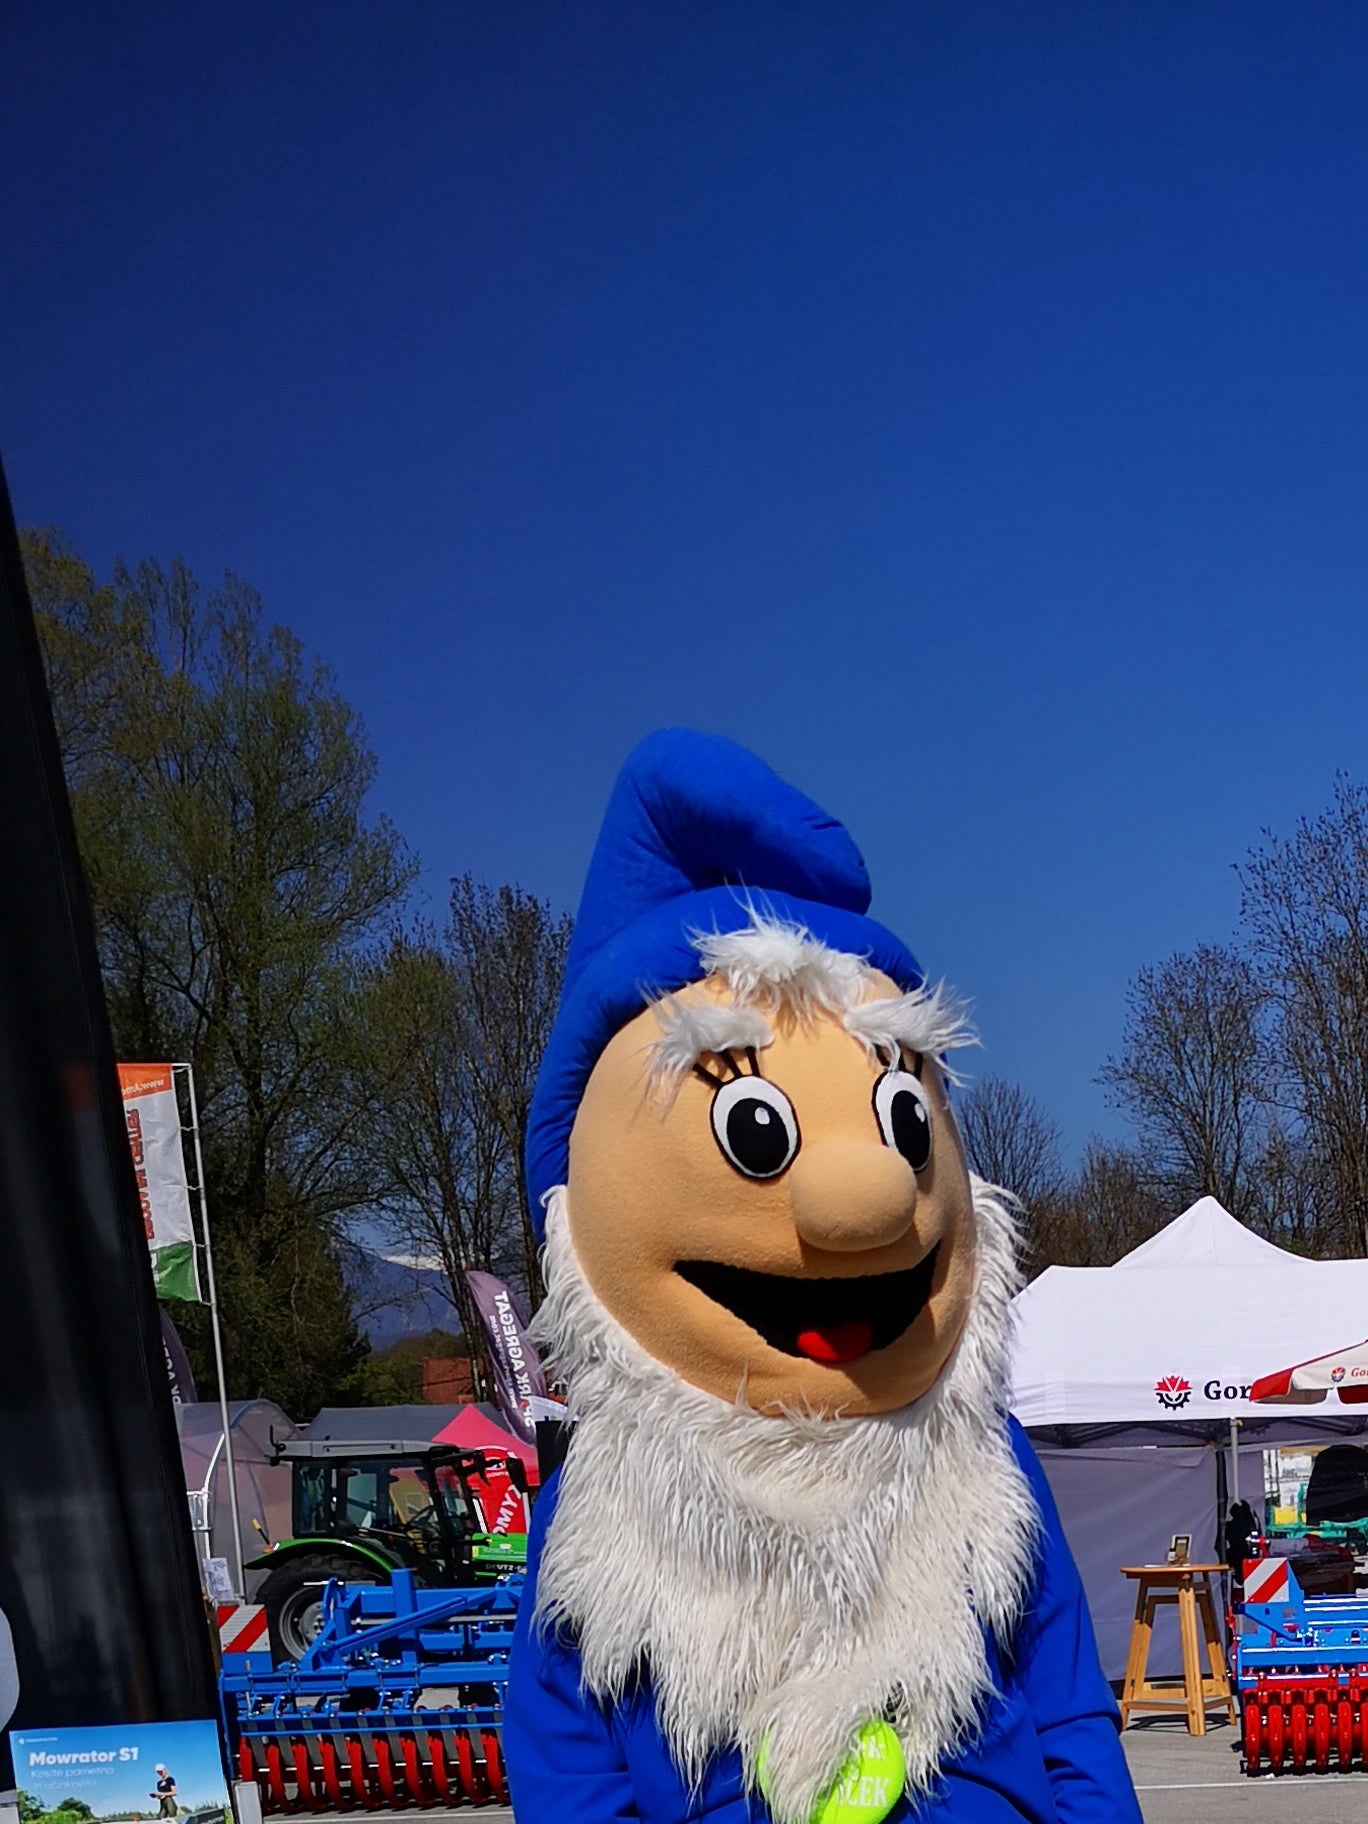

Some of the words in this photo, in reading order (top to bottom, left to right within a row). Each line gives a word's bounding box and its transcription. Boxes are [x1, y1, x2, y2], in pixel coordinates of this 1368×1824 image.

[1204, 1380, 1250, 1400] Gor
[29, 1751, 116, 1767] Mowrator
[119, 1747, 139, 1762] S1
[31, 1768, 65, 1779] Kosite
[65, 1766, 115, 1779] pametno
